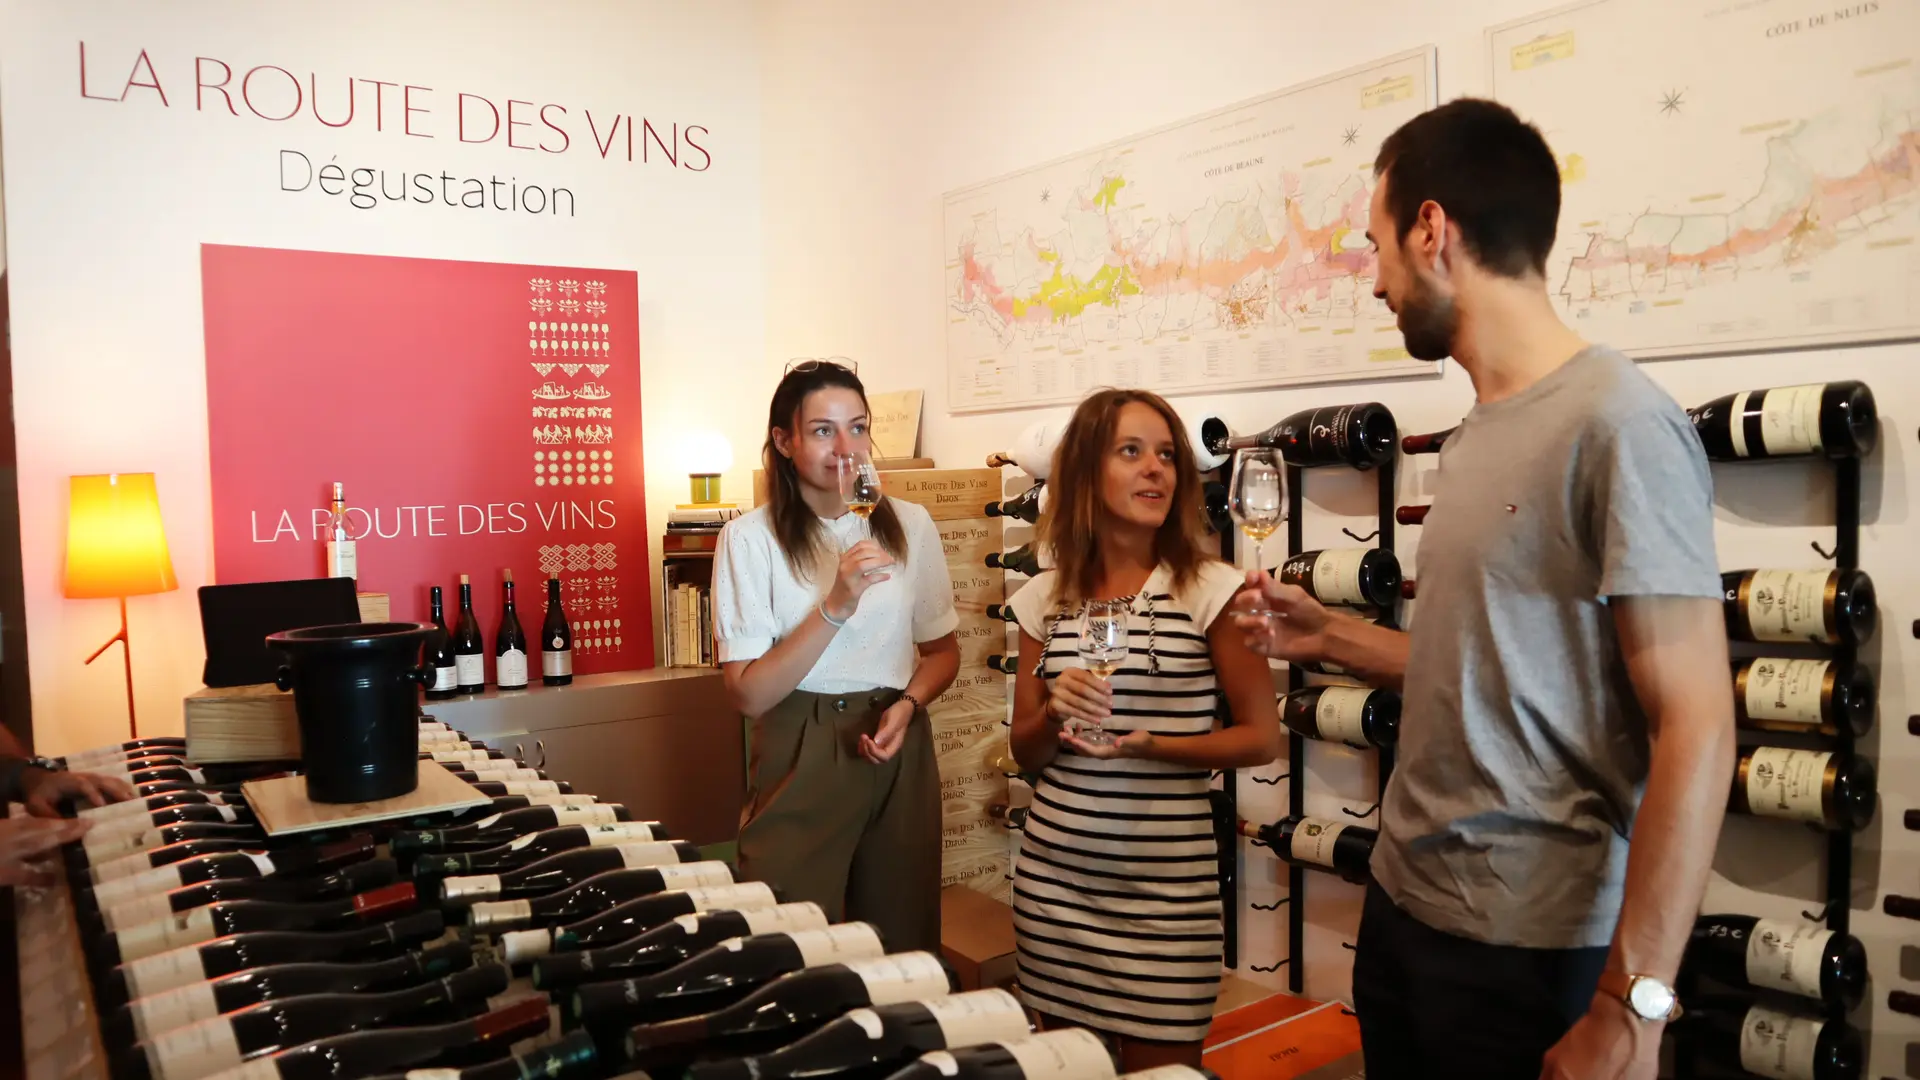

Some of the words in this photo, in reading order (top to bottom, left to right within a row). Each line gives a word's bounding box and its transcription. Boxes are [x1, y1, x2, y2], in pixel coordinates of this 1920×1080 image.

[79, 41, 169, 108] LA
[194, 56, 434, 139] ROUTE
[458, 92, 570, 154] DES
[585, 109, 711, 172] VINS
[279, 148, 575, 217] Dégustation
[250, 508, 300, 543] LA
[458, 502, 527, 536] DES
[535, 500, 617, 532] VINS
[943, 544, 960, 553] IJON
[933, 731, 954, 741] OUTE
